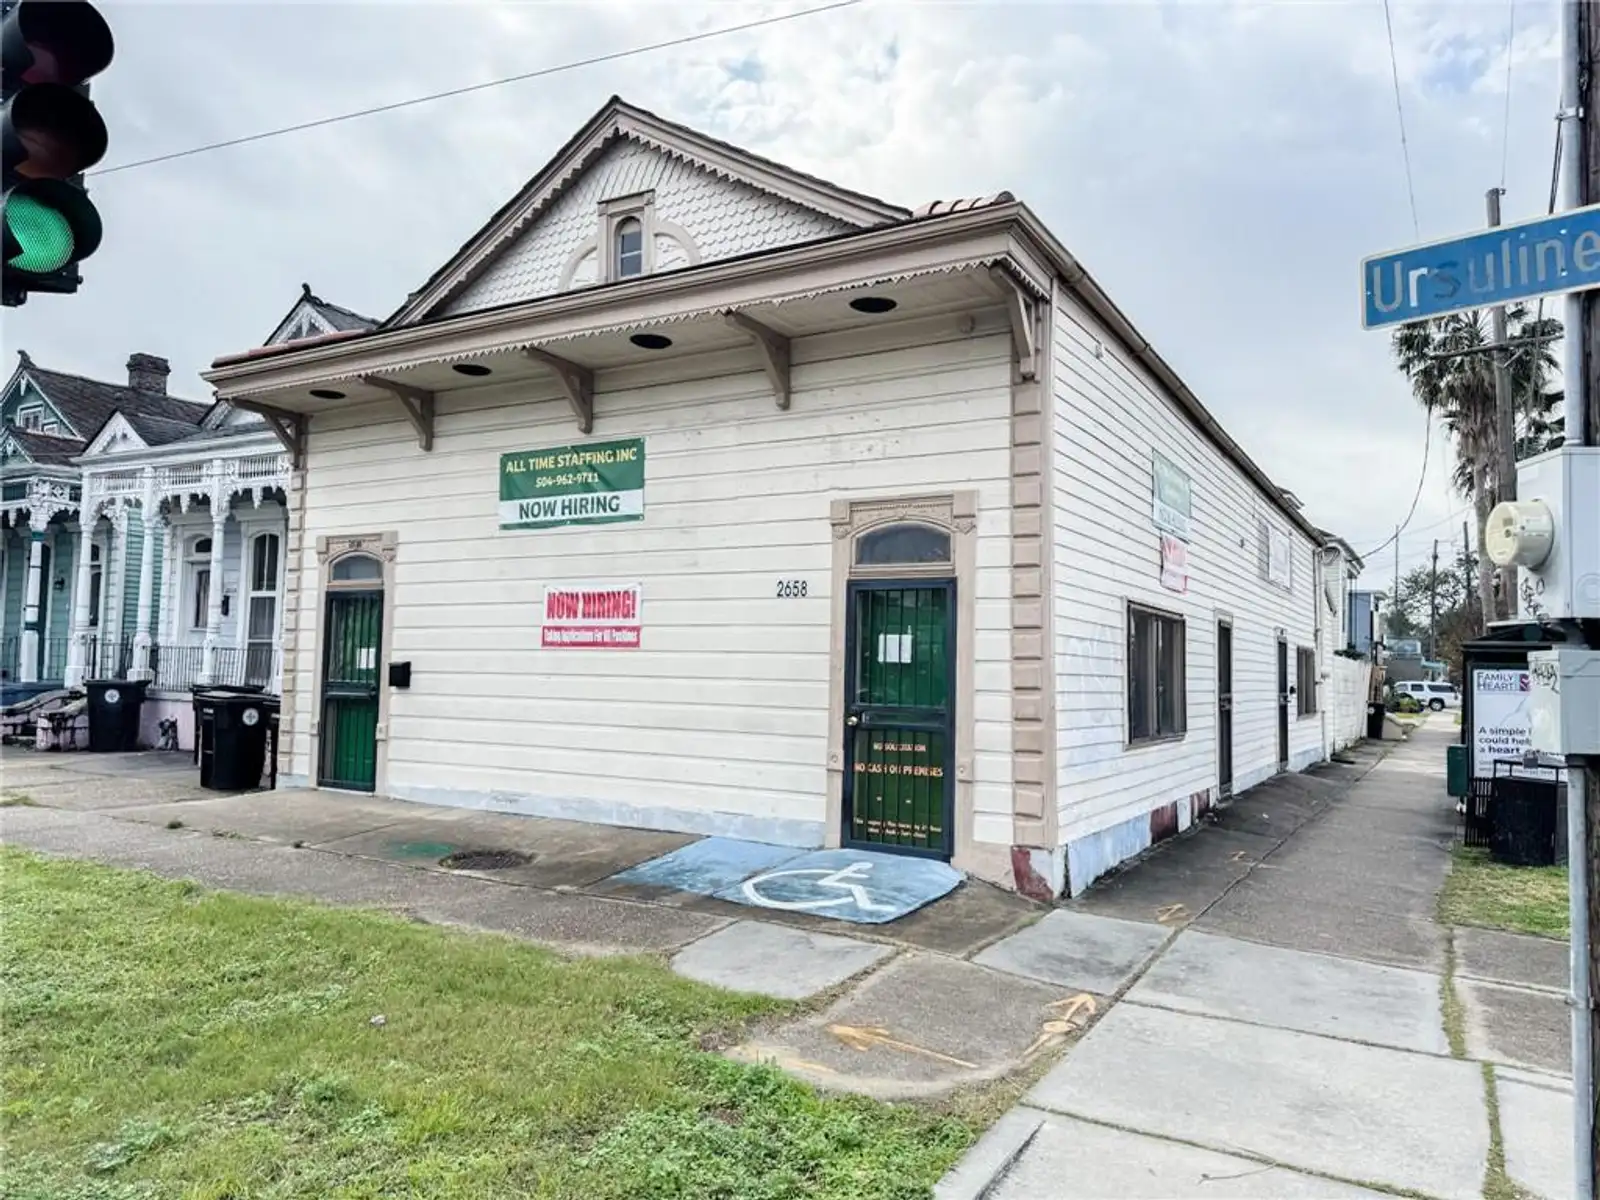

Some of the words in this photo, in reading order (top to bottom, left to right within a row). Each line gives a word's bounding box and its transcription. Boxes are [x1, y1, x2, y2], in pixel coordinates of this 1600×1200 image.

[506, 460, 526, 473] ALL
[529, 456, 556, 471] TIME
[557, 450, 614, 468] STAFFING
[616, 447, 637, 461] INC
[518, 500, 557, 520] NOW
[560, 495, 620, 516] HIRING
[776, 580, 808, 597] 2658
[547, 591, 579, 619] NOW
[582, 590, 636, 619] HIRING!
[1477, 672, 1513, 681] FAMILY
[1477, 683, 1513, 692] HEART
[1489, 726, 1526, 736] simple
[1479, 736, 1509, 744] could
[1488, 745, 1520, 754] heart
